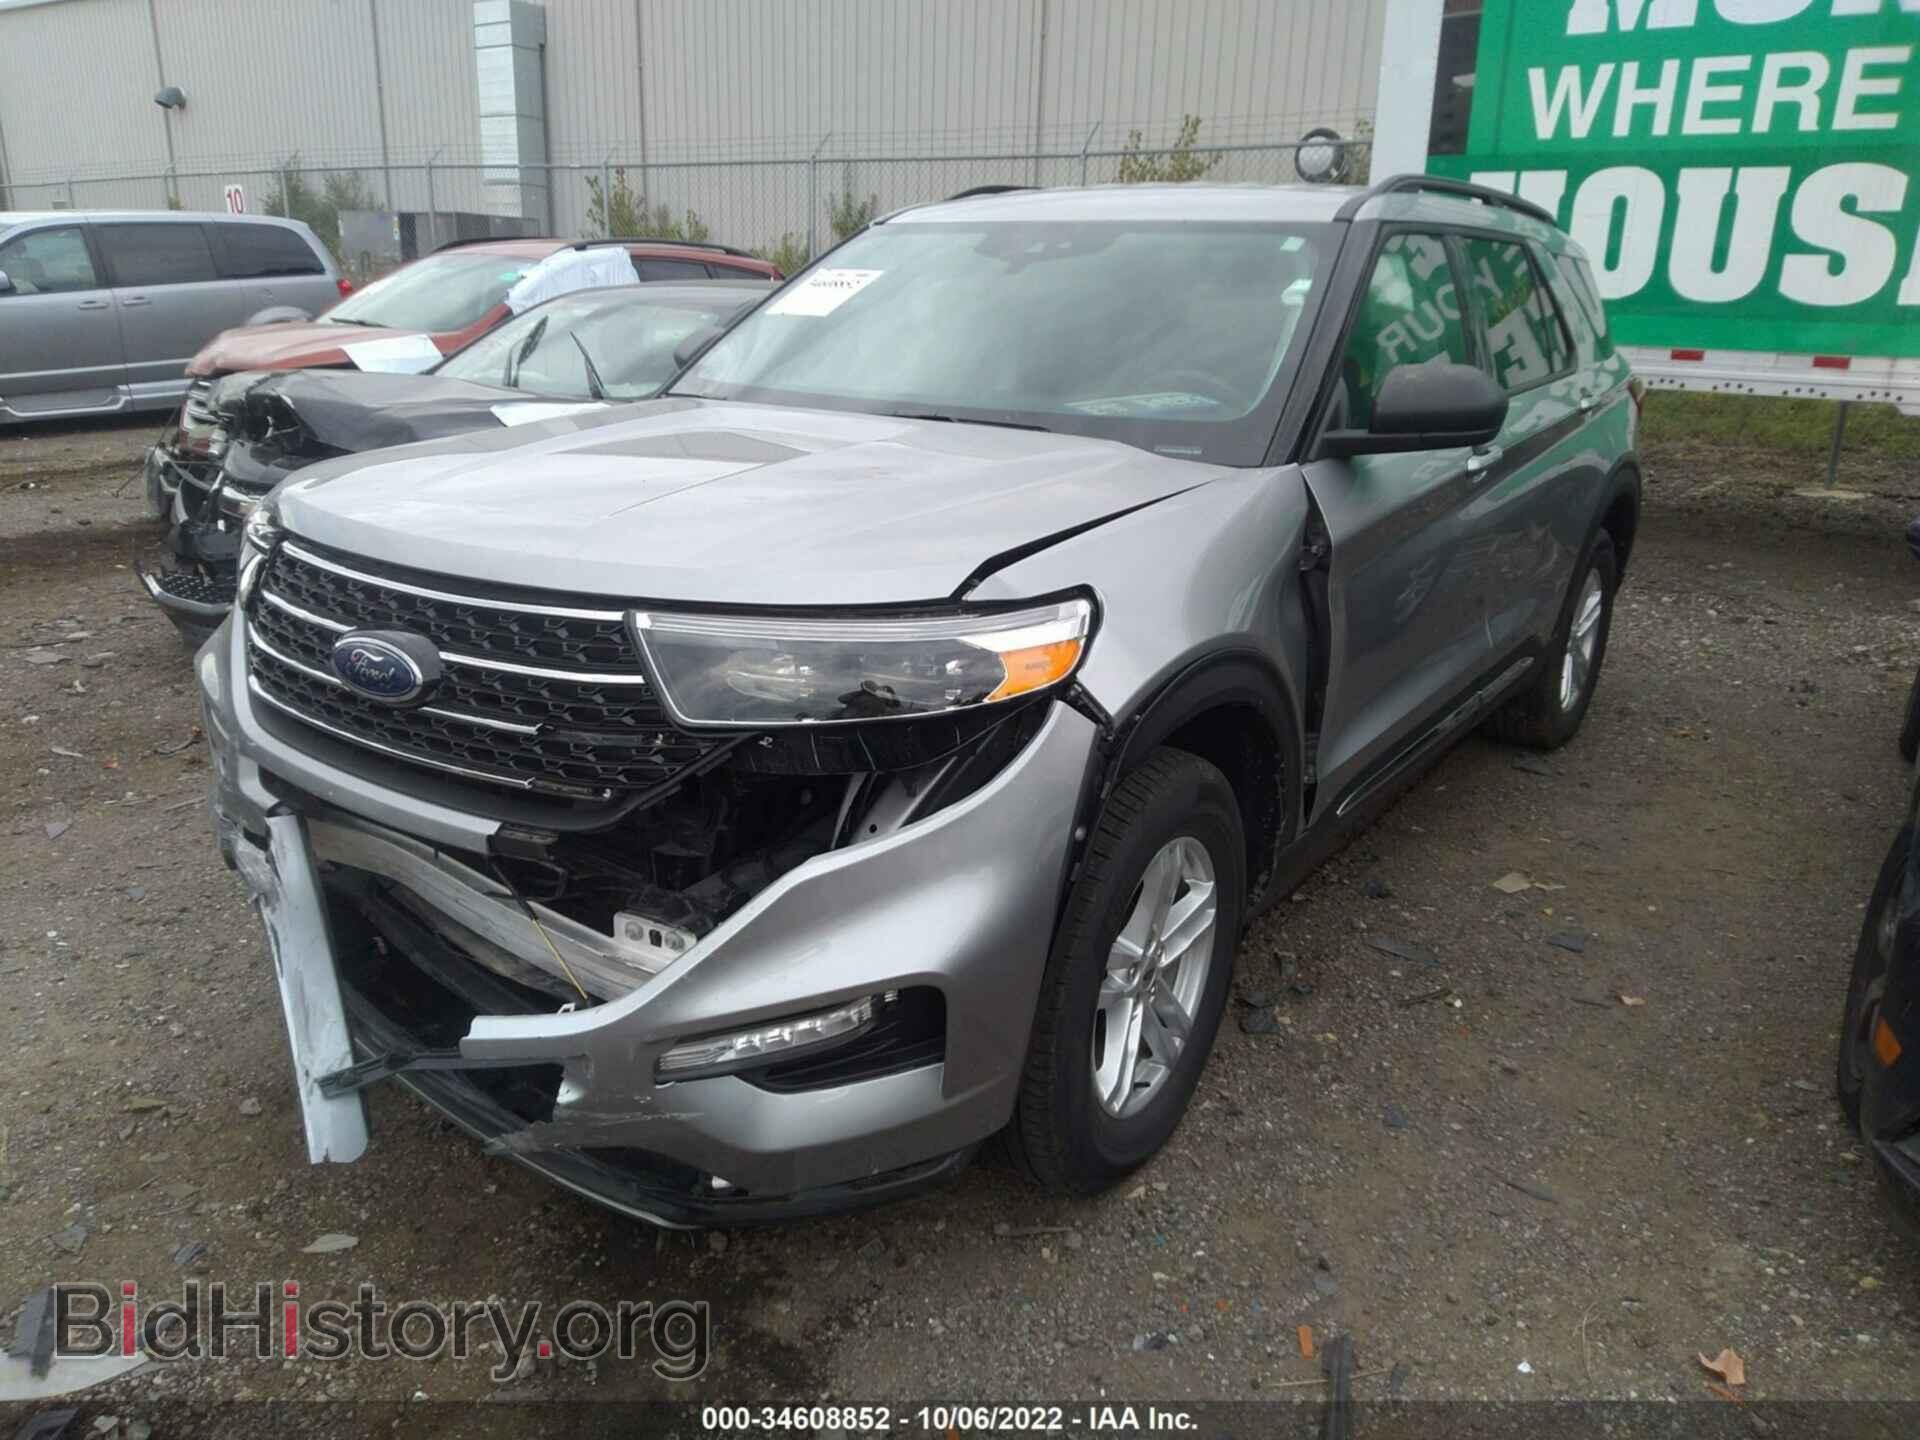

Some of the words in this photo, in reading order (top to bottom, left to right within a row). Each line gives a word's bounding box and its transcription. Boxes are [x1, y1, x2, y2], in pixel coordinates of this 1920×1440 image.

[1527, 45, 1912, 140] WHERE
[226, 188, 244, 214] 10
[1470, 161, 1920, 307] OUS
[350, 648, 396, 688] Ford
